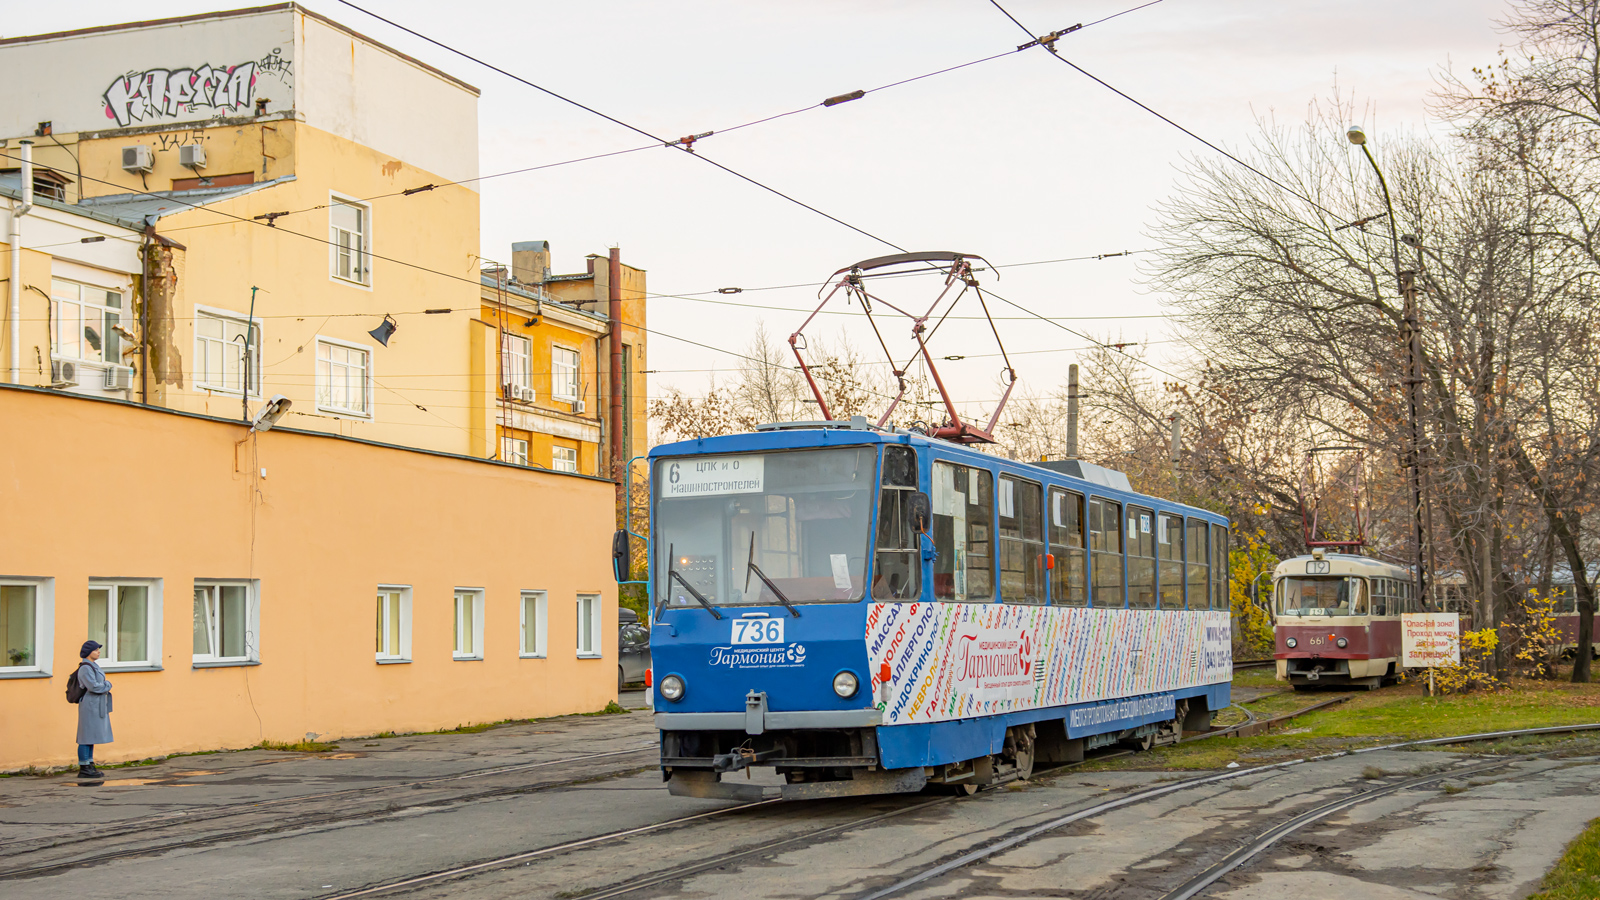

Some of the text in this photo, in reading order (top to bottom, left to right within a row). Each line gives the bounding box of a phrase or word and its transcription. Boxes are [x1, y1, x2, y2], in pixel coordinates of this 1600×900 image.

[669, 463, 680, 484] 6
[696, 461, 717, 473] ЦПК
[721, 462, 729, 471] и
[1313, 562, 1325, 574] 19
[735, 620, 780, 643] 736
[1309, 637, 1325, 645] 661
[1407, 629, 1433, 639] Проход
[708, 645, 785, 669] Гармония
[957, 634, 1018, 688] Гармония
[890, 615, 939, 722] ЭНДОКРИНОЛОГ
[908, 649, 939, 720] НЕВРОЛОГ
